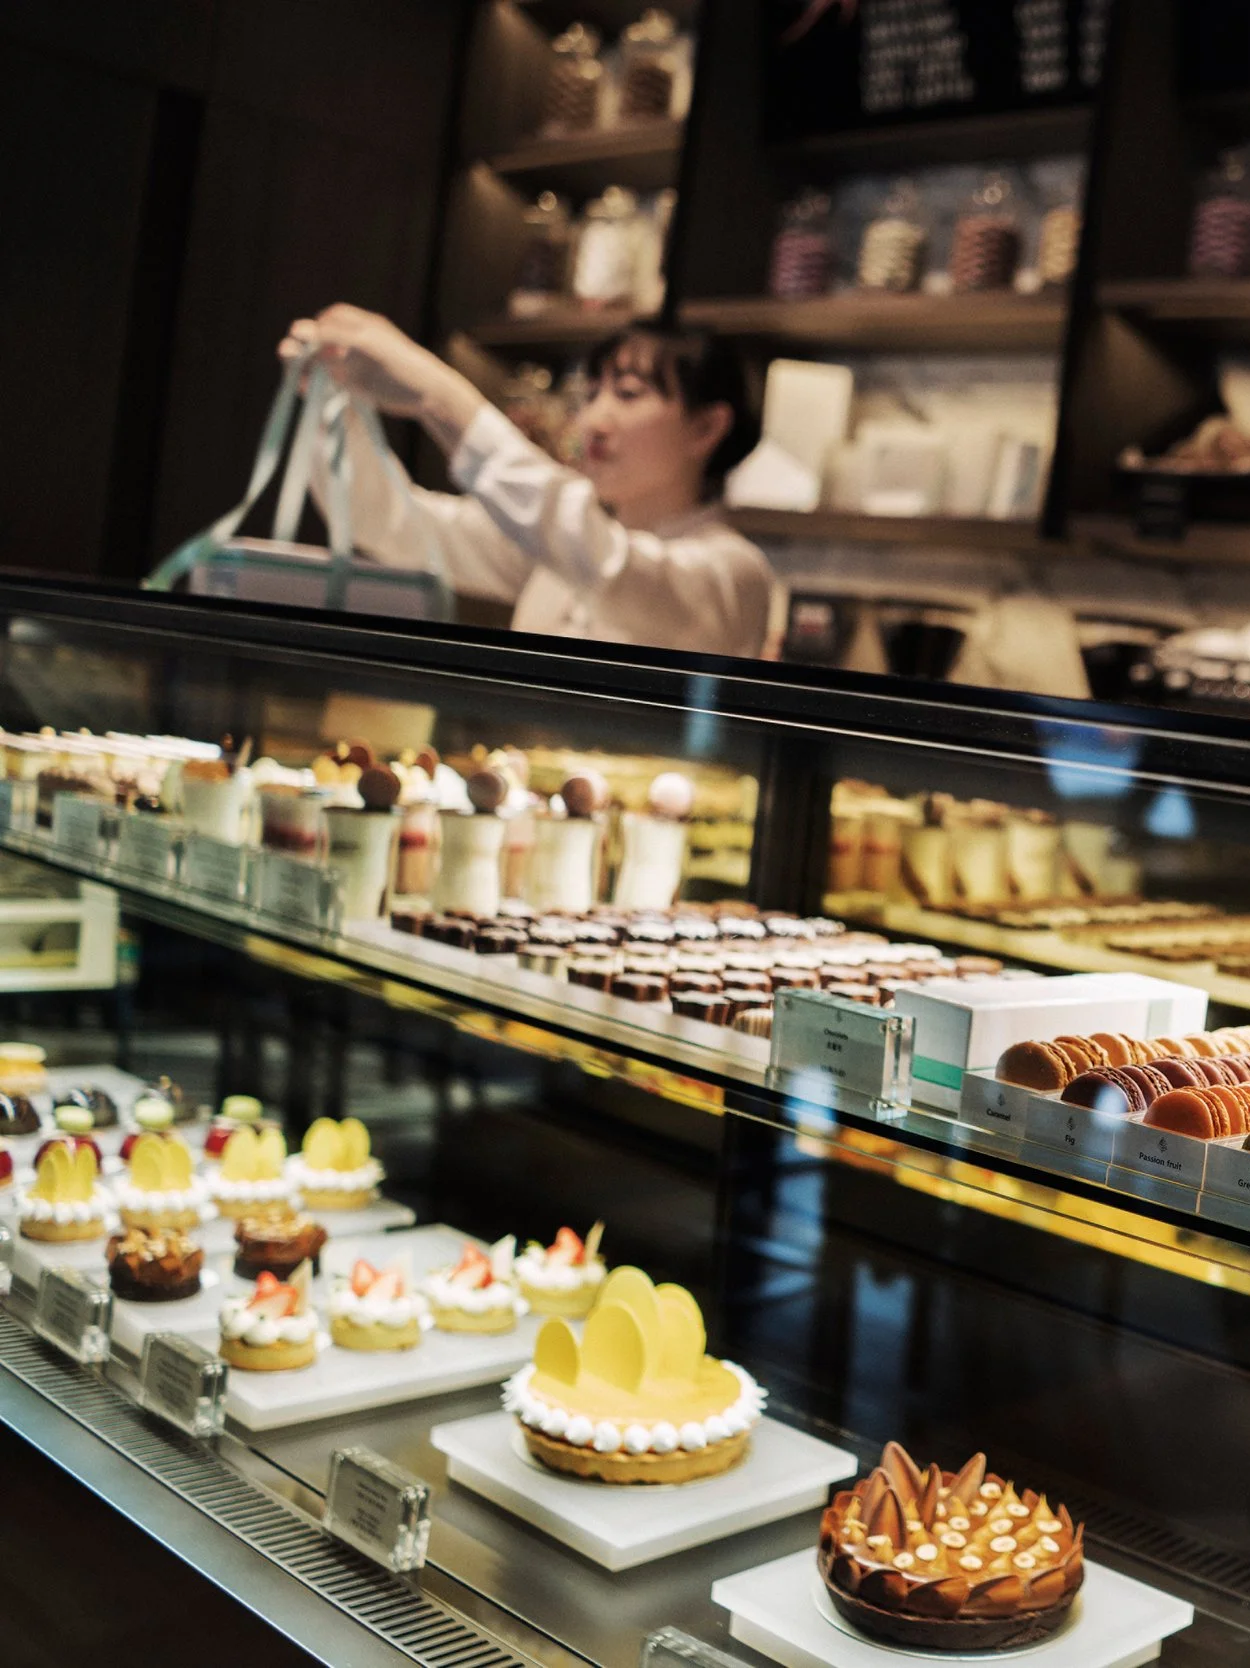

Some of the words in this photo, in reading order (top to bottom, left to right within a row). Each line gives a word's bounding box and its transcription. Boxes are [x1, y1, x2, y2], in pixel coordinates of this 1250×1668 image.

[986, 1108, 1011, 1121] Caramel
[1064, 1134, 1076, 1146] Fig
[1139, 1151, 1165, 1166] Passion
[1166, 1159, 1182, 1171] fruit
